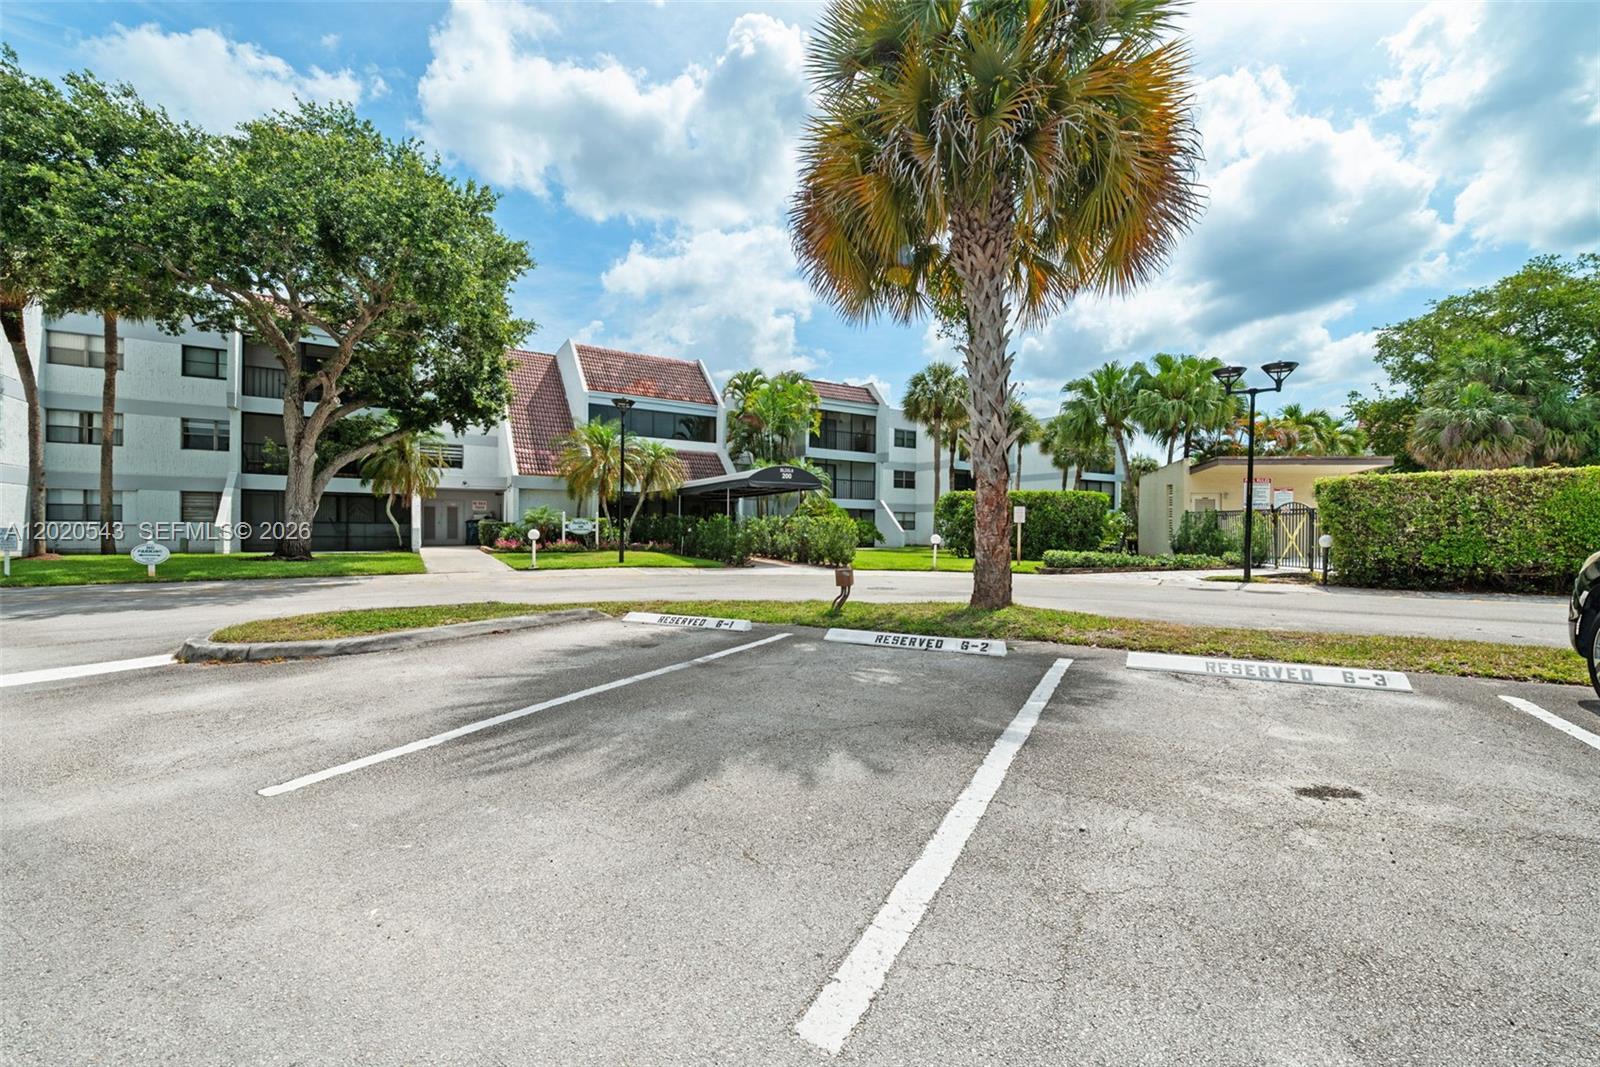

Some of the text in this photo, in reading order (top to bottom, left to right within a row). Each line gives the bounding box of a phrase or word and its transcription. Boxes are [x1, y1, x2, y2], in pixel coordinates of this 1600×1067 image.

[657, 615, 708, 627] RESERVED
[874, 634, 944, 649] RESERVED
[1205, 660, 1313, 682] RESERVED
